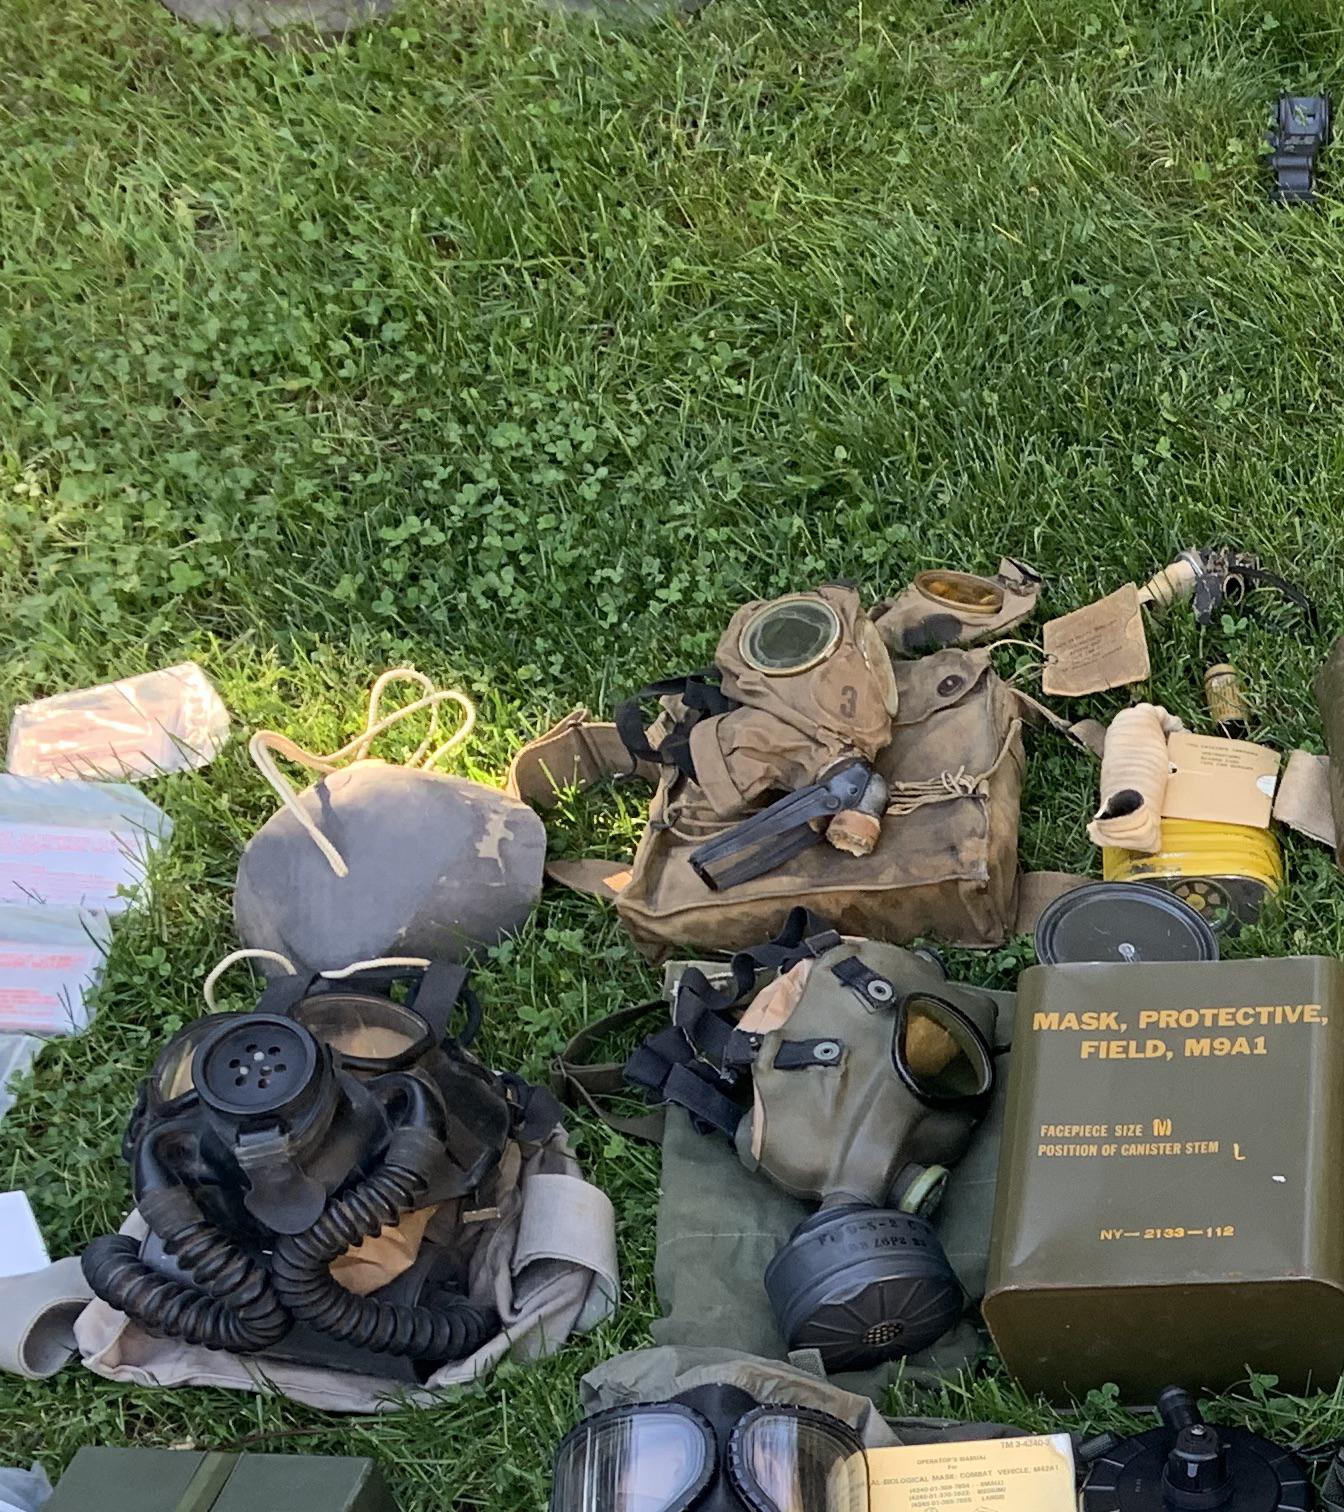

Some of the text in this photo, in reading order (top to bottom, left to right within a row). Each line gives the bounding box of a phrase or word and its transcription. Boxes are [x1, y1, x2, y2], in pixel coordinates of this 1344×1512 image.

[840, 685, 858, 719] 3
[1033, 1004, 1329, 1033] MASK, PROTECTIVE,
[1080, 1036, 1268, 1061] FIELD, M9A1
[1040, 1124, 1108, 1137] FACEPIECE
[1114, 1124, 1144, 1137] SIZE
[1037, 1143, 1098, 1157] POSITION
[1101, 1143, 1117, 1156] OF
[1120, 1142, 1182, 1156] CANISTER
[1184, 1141, 1219, 1154] STEM
[1001, 1441, 1014, 1449] TM
[959, 1470, 993, 1479] COMBAT
